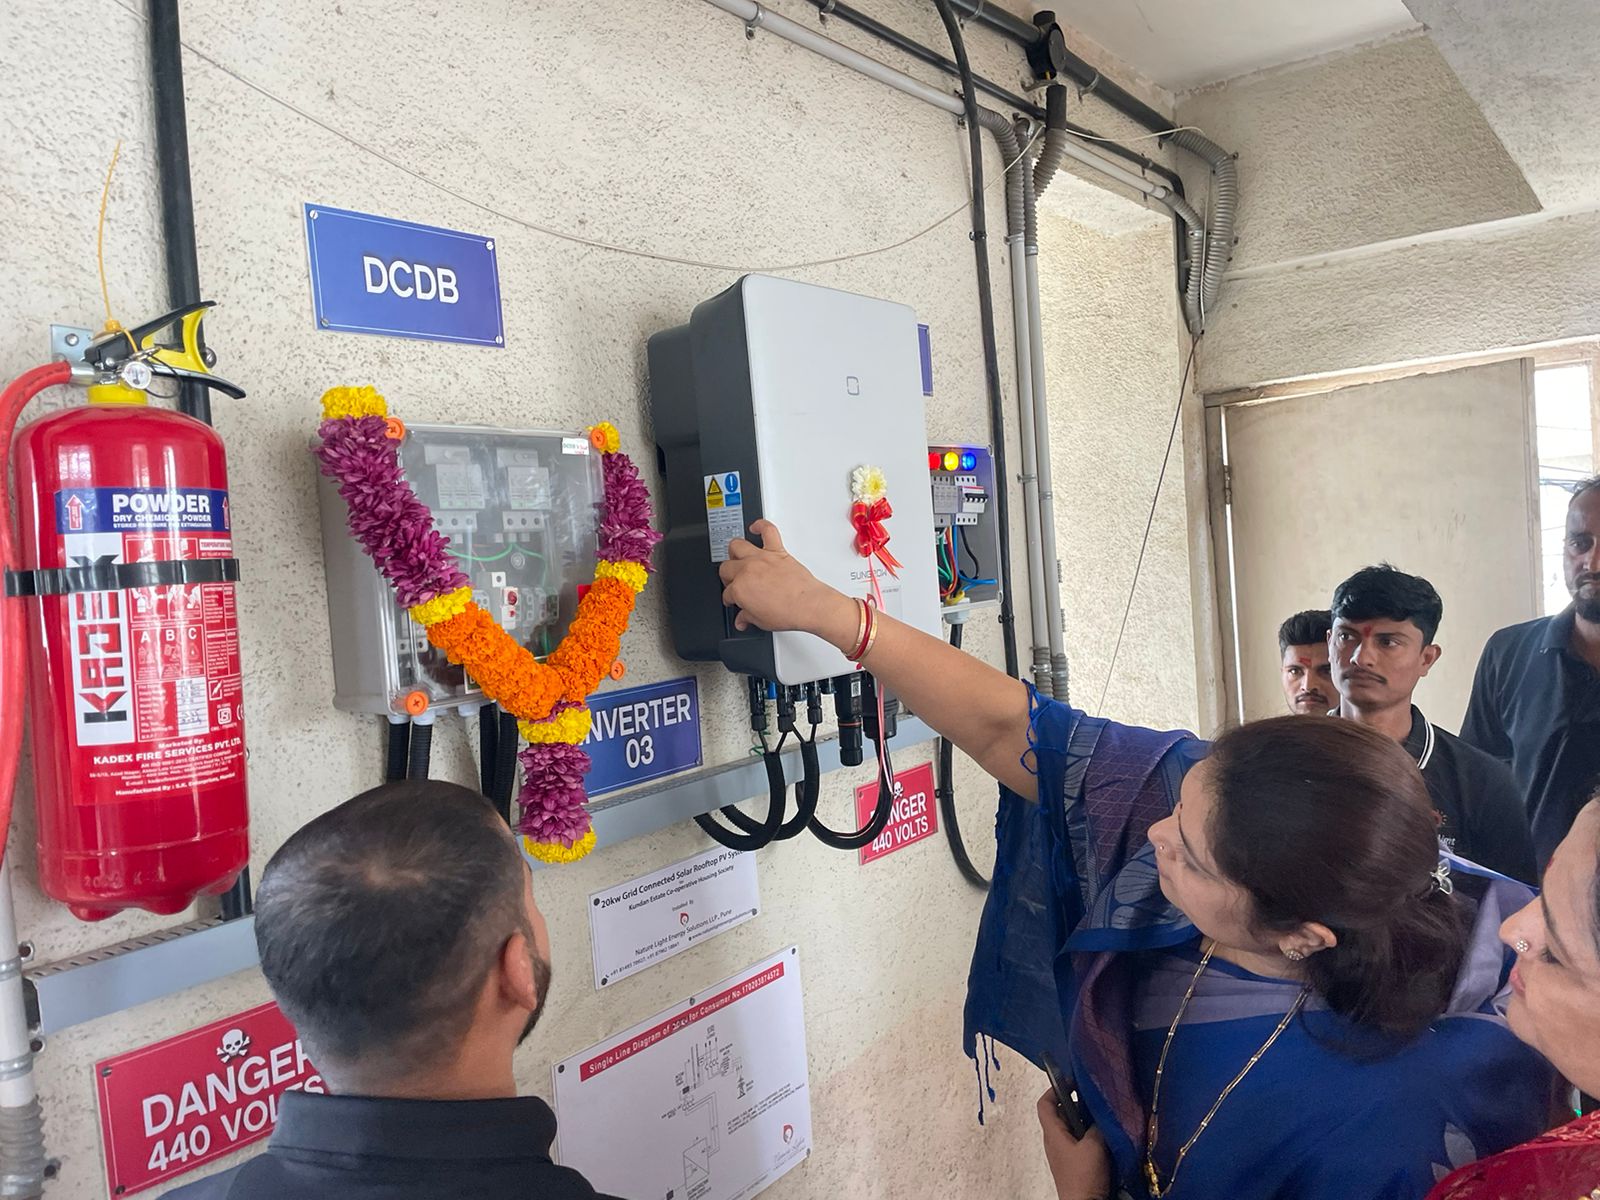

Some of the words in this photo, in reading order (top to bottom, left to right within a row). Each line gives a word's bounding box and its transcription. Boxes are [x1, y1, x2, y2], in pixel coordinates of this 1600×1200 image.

[363, 255, 459, 304] DCDB
[112, 493, 210, 513] POWDER
[113, 514, 132, 522] DRY
[182, 514, 211, 522] POWDER
[141, 631, 151, 643] A
[165, 629, 175, 641] B
[188, 627, 197, 639] C
[580, 693, 691, 745] NVERTER
[93, 754, 133, 765] KADEX
[136, 751, 161, 762] FIRE
[165, 743, 213, 758] SERVICES
[158, 738, 192, 749] Marketed
[626, 735, 654, 768] 03
[870, 791, 927, 826] NGER
[872, 831, 892, 853] 440
[894, 815, 929, 843] VOLTS
[601, 895, 621, 909] 20kw
[622, 888, 638, 900] Grid
[639, 874, 676, 893] Connected
[676, 867, 693, 880] Solar
[693, 857, 718, 874] Rooftop
[718, 853, 728, 862] PV
[629, 898, 649, 911] Kundan
[650, 891, 666, 903] Estate
[666, 880, 698, 896] Co-operative
[698, 871, 717, 883] Housing
[717, 865, 734, 875] Society
[635, 943, 653, 957] Nature
[654, 936, 669, 948] Light
[669, 929, 686, 943] Energy
[685, 919, 709, 934] Solutions
[720, 909, 732, 919] Pune
[589, 1056, 613, 1074] Single
[615, 1047, 631, 1061] Line
[633, 1032, 661, 1052] Diagram
[663, 1025, 670, 1035] of
[689, 1011, 699, 1021] for
[700, 996, 731, 1016] Consumer
[148, 1124, 211, 1171] 440
[220, 1075, 324, 1142] VOLS
